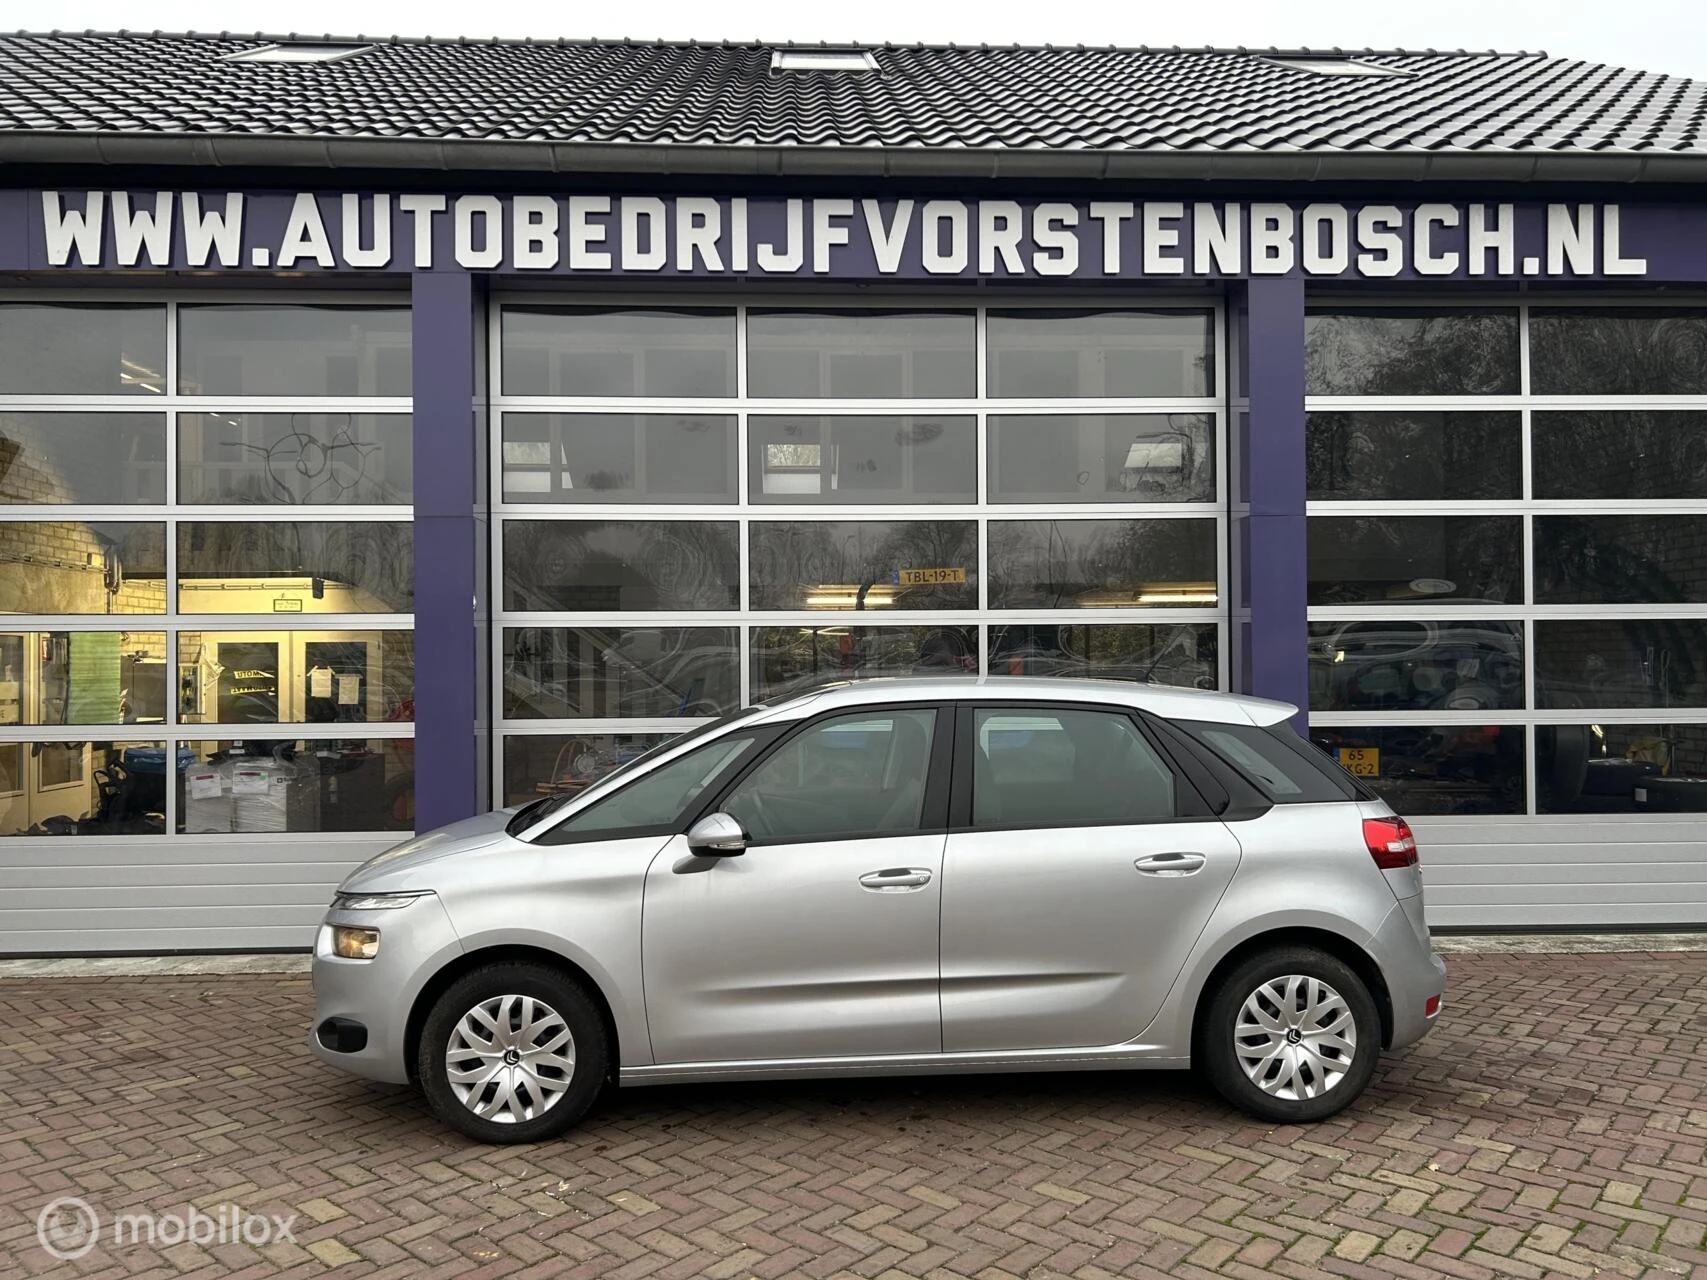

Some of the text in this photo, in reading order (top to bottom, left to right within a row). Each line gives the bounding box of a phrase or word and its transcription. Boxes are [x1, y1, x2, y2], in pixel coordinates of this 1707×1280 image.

[42, 190, 1648, 277] WWW.AUTOBEDRIJFVORSTENBOSCH.NL
[906, 570, 959, 583] TBL-19-T
[1348, 749, 1365, 761] 65
[1342, 763, 1375, 774] KG-2
